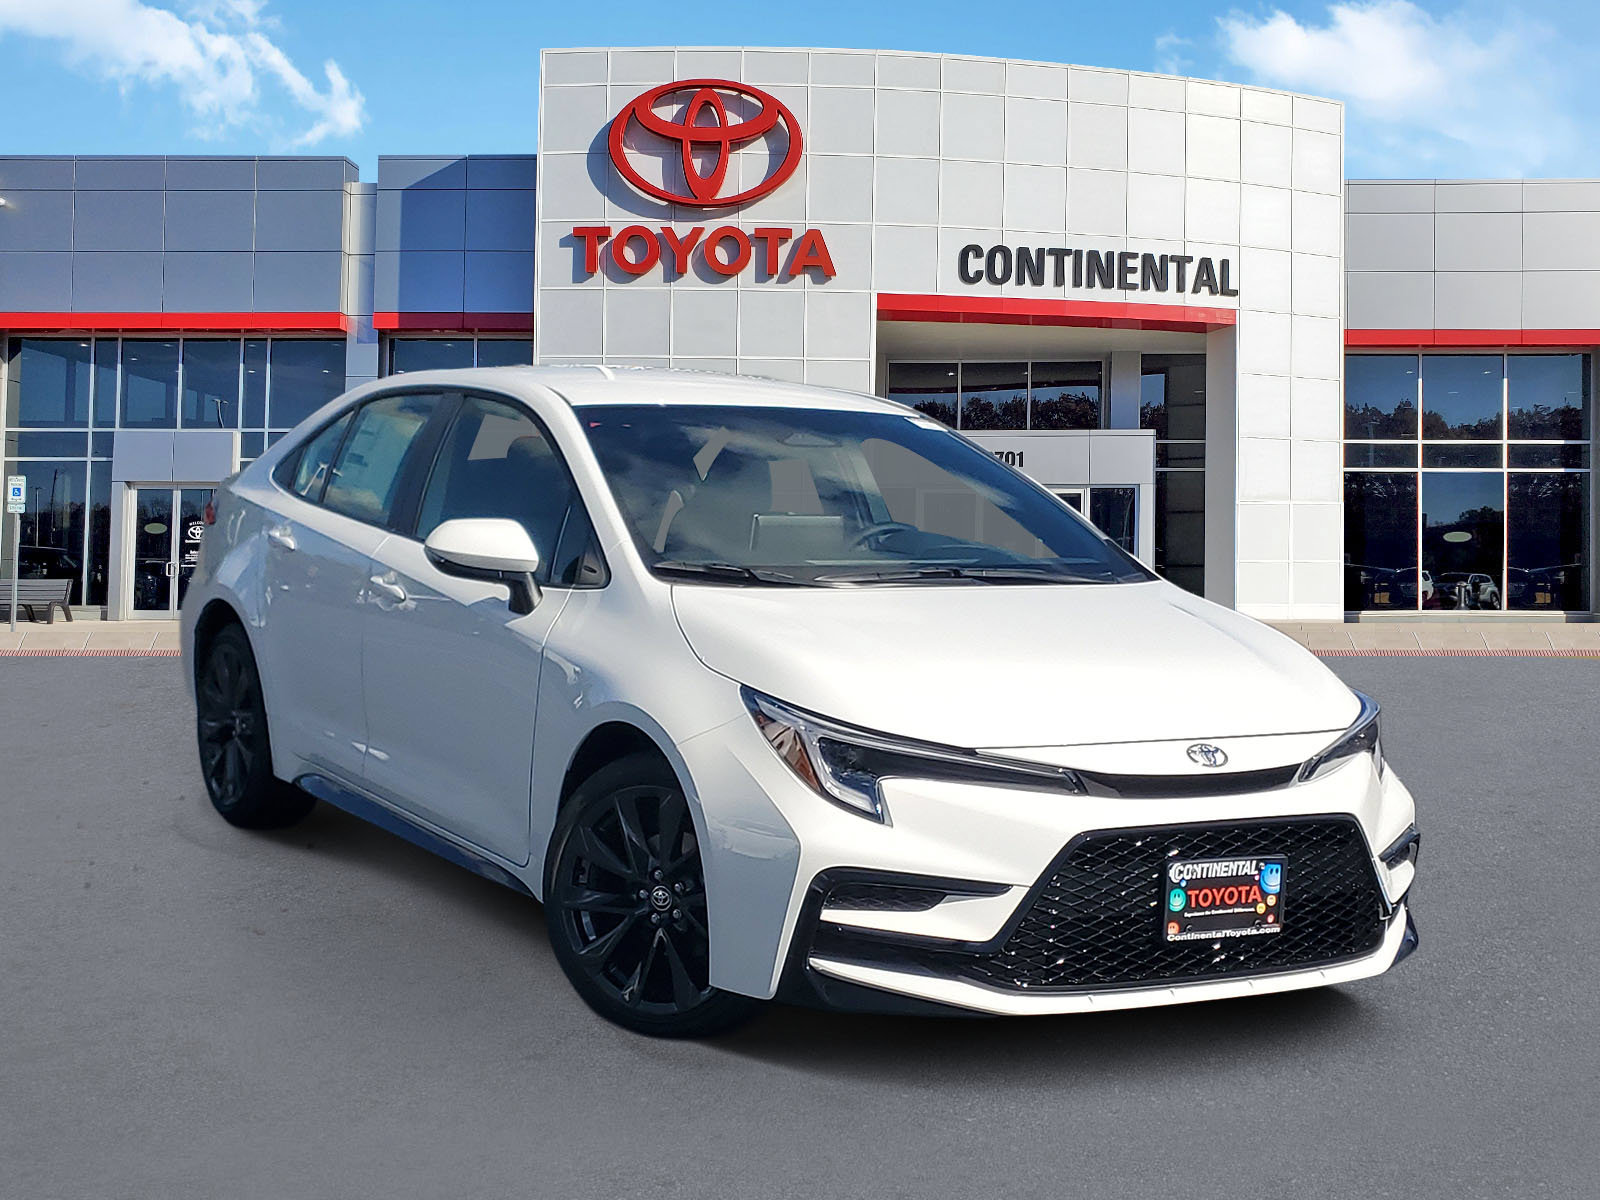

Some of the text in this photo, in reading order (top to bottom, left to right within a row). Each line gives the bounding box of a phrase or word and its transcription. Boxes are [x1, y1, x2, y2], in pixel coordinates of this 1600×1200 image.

[572, 225, 836, 276] TOYOTA
[958, 244, 1239, 297] CONTINENTAL
[990, 451, 1024, 468] 701
[1169, 860, 1258, 883] CONTINENTAL
[1187, 885, 1262, 908] TOYOTA
[1166, 927, 1281, 942] ContinentalToyota.com
